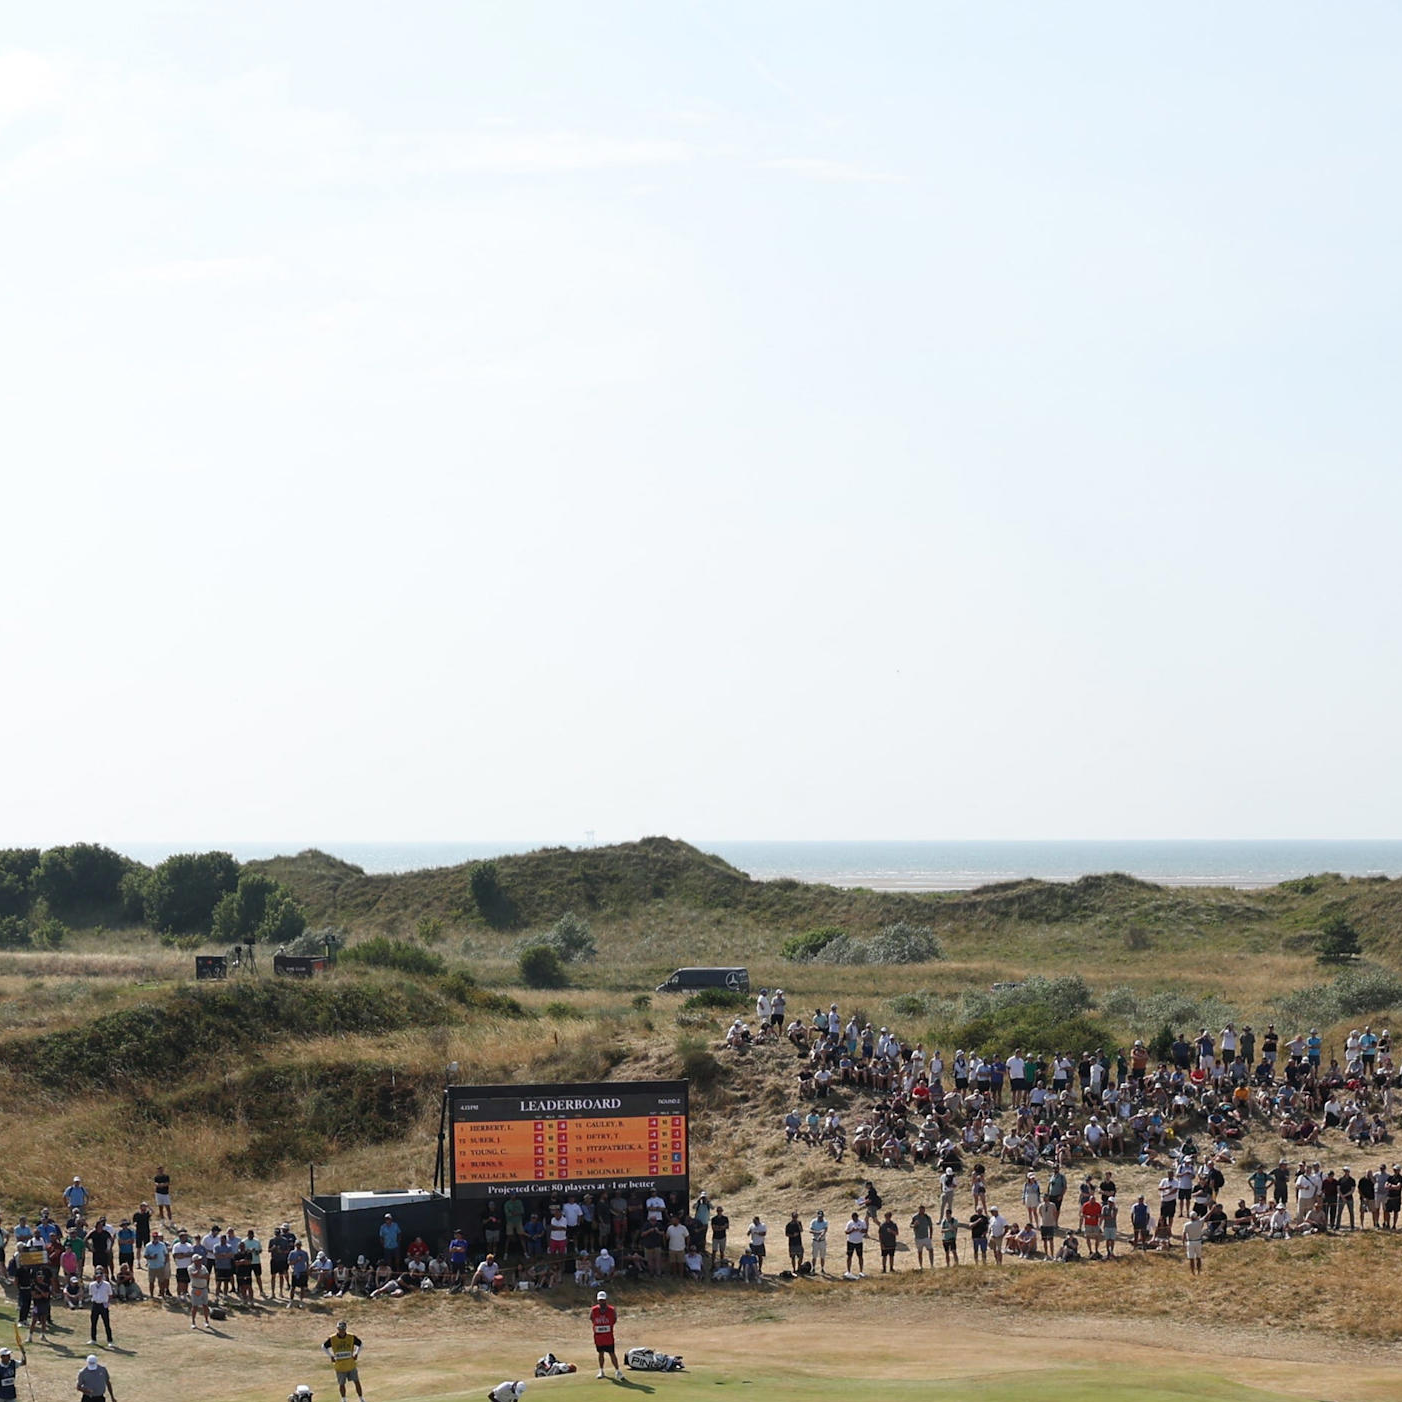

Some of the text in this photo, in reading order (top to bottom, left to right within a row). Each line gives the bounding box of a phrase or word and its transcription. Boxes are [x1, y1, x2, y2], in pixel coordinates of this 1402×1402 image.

[520, 1098, 621, 1111] LEADERBOARD
[488, 1185, 529, 1195] Projected
[531, 1184, 550, 1192] Cut:
[564, 1182, 595, 1193] players
[629, 1180, 655, 1189] better
